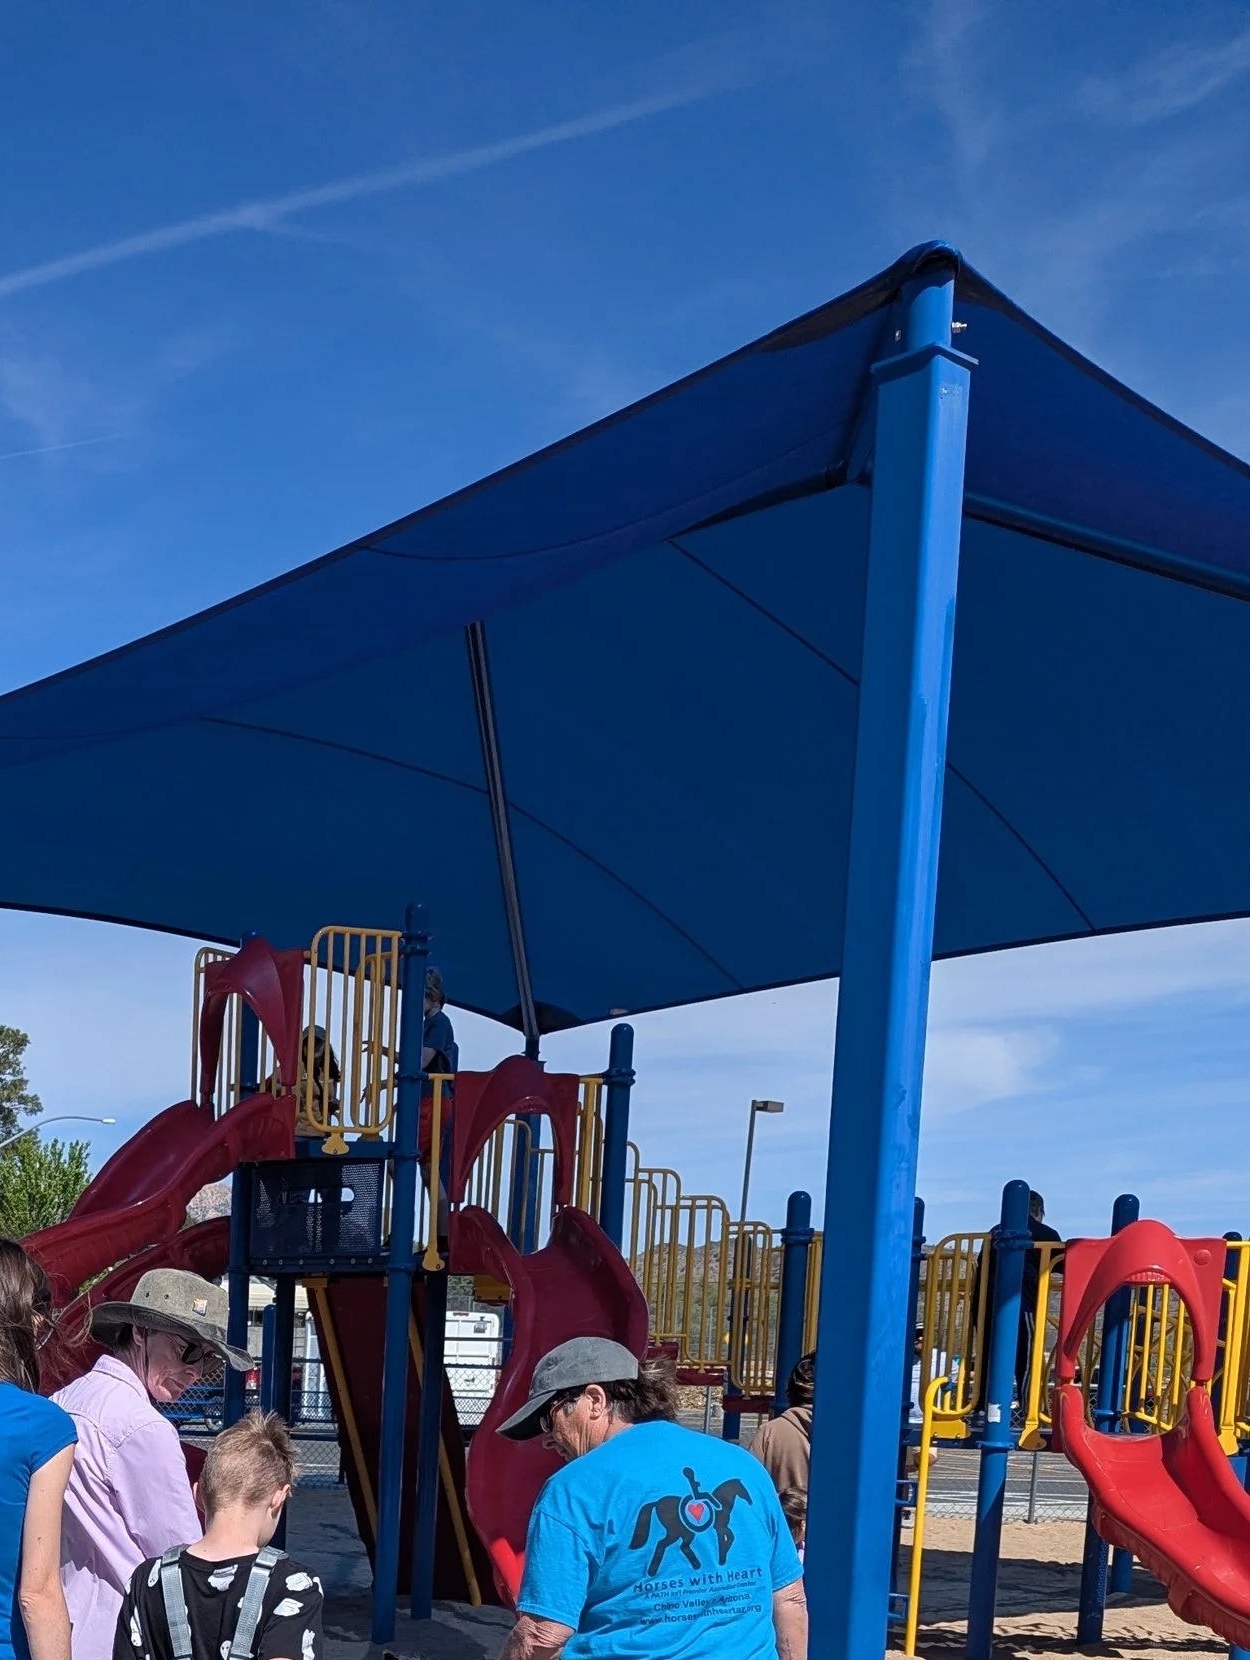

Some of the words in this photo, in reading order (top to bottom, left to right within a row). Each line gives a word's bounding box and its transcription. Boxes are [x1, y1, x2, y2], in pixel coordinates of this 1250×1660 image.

[633, 1579, 684, 1592] Horses
[690, 1572, 723, 1586] with
[727, 1568, 762, 1581] Heart
[653, 1602, 680, 1612] Chino
